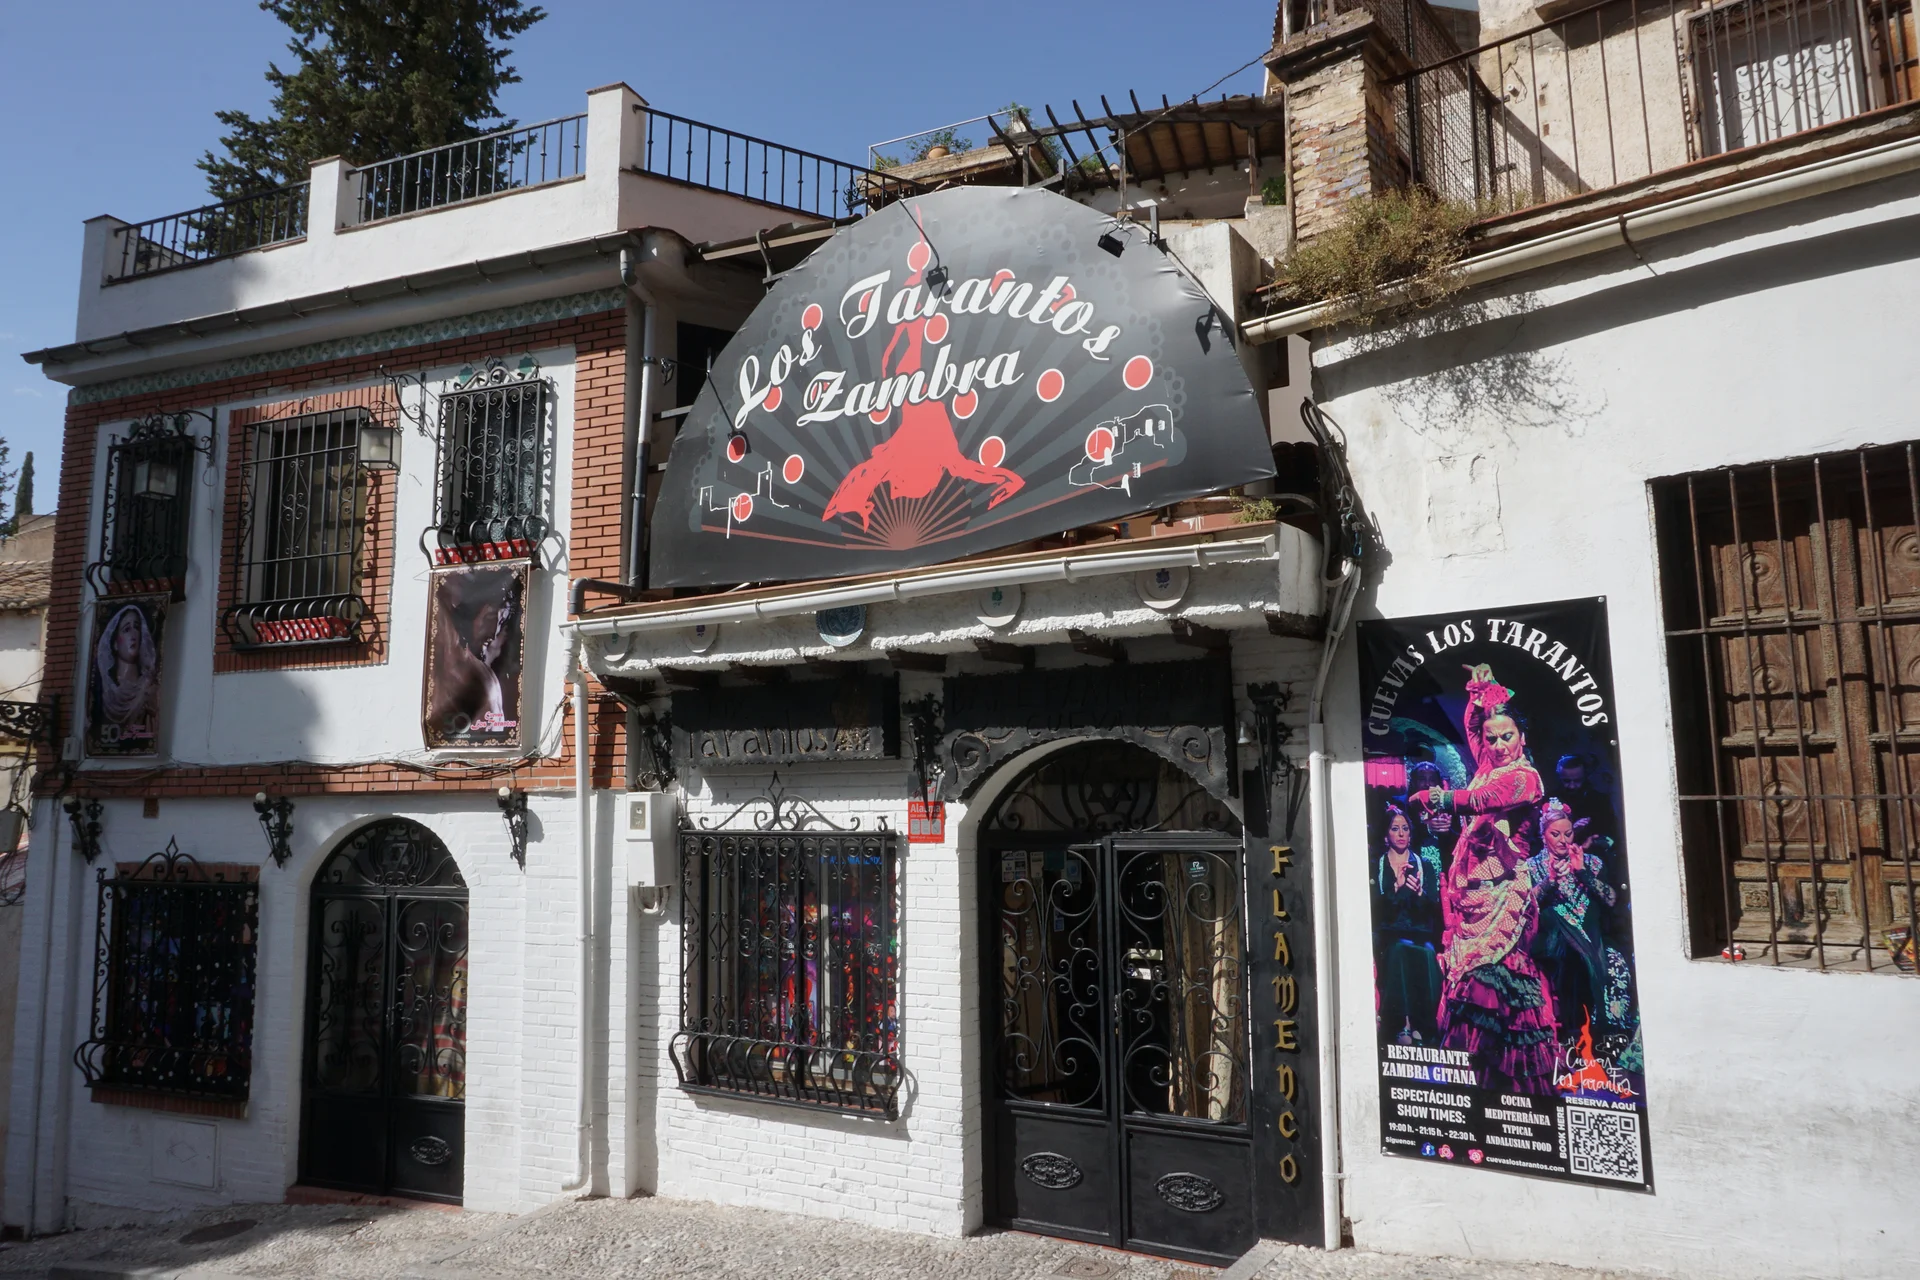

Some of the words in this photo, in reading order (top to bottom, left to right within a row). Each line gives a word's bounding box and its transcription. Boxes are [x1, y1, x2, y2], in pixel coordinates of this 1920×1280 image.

[734, 327, 822, 428] Los
[840, 269, 1121, 361] Tarantos
[797, 343, 1024, 427] Zambra
[1368, 645, 1425, 736] CUEVAS
[1426, 619, 1475, 654] LOS
[1487, 618, 1609, 727] TARANTOS
[910, 803, 941, 813] Alama
[1268, 845, 1297, 1184] FLAMENCO
[1387, 1044, 1470, 1067] RESTAURANTE
[1566, 1046, 1622, 1075] Cuevas
[1382, 1062, 1430, 1080] ZAMBRA
[1433, 1066, 1477, 1085] GITANA
[1576, 1066, 1639, 1095] Tarantos
[1390, 1087, 1471, 1108] ESPECTÁCULOS
[1501, 1094, 1532, 1108] COCINA
[1565, 1096, 1610, 1109] RESERVA
[1611, 1101, 1636, 1111] AQUÍ
[1397, 1103, 1428, 1119] SHOW
[1429, 1106, 1466, 1124] TIMES:
[1484, 1107, 1551, 1126] MEDITERRÁNEA
[1556, 1106, 1566, 1131] HERE
[1388, 1122, 1407, 1132] 19:00
[1407, 1123, 1414, 1133] h.
[1419, 1125, 1436, 1136] 21:15
[1437, 1128, 1444, 1137] h.
[1449, 1130, 1468, 1140] 22:30
[1469, 1131, 1477, 1142] h.
[1502, 1124, 1533, 1137] TYPICAL
[1485, 1135, 1531, 1150] ANDALUSIAN
[1532, 1141, 1552, 1153] FOOD
[1558, 1132, 1568, 1159] BOOK
[1486, 1156, 1566, 1172] cuevaslostarantos.com
